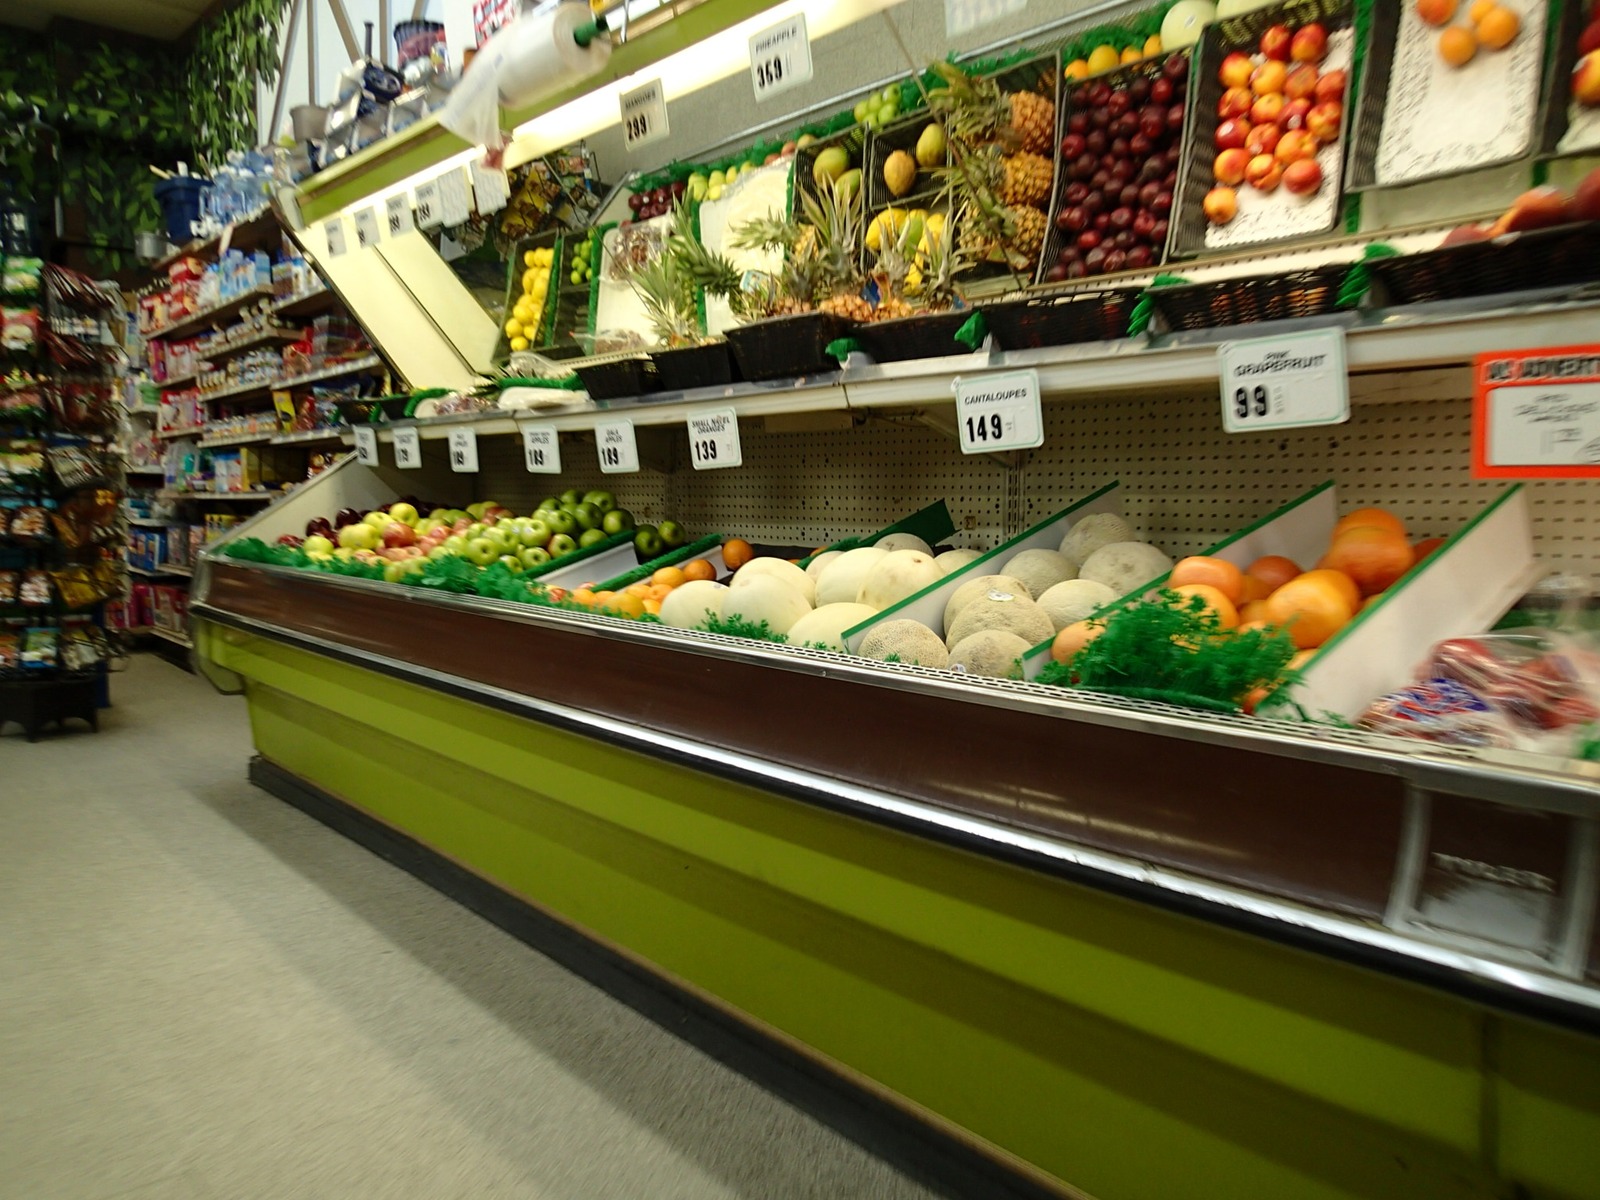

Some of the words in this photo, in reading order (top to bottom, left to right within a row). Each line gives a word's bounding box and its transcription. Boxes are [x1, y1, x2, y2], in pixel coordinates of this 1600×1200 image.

[755, 25, 797, 55] PINEAPPLE
[1233, 353, 1327, 377] GRAPEFRUIT
[964, 388, 1027, 405] CANTALOUPES
[1235, 384, 1267, 418] 99
[692, 420, 710, 428] SMALL
[698, 424, 725, 434] ORANGES
[966, 413, 1002, 442] 149
[695, 439, 717, 461] 139
